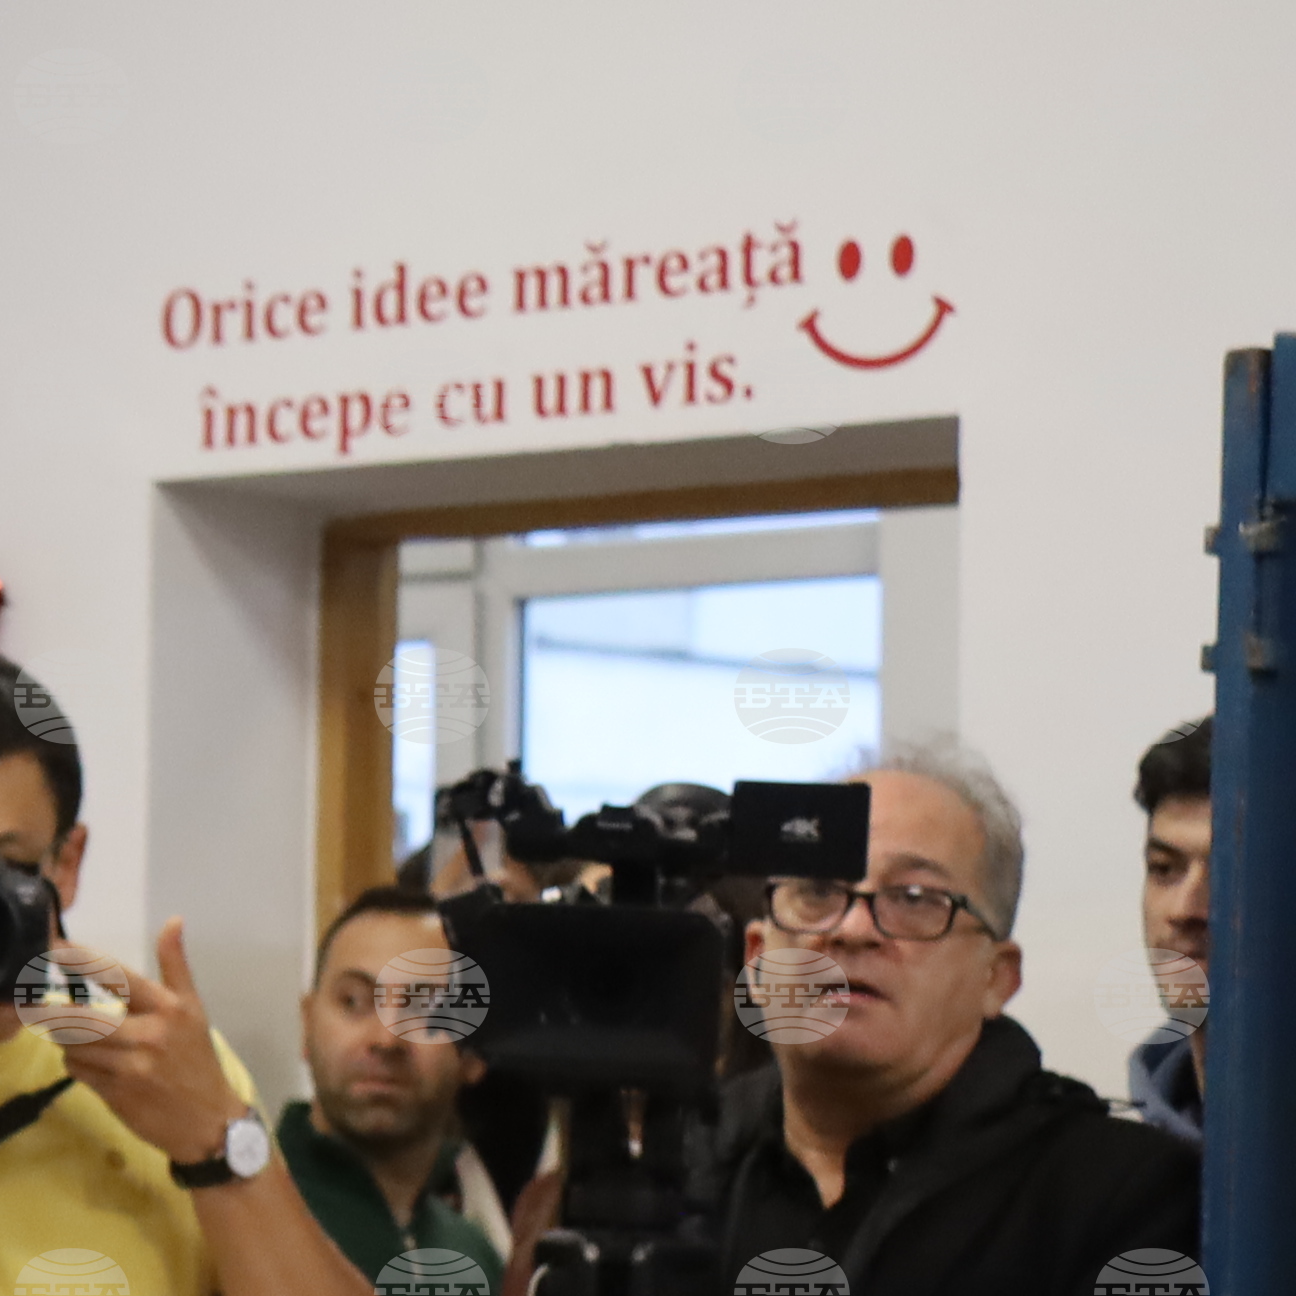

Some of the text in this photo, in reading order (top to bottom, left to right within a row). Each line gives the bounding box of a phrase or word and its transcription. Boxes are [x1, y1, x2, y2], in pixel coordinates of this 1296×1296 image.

[160, 217, 802, 351] Orice idee măreață
[200, 340, 753, 455] începe cu un vis.
